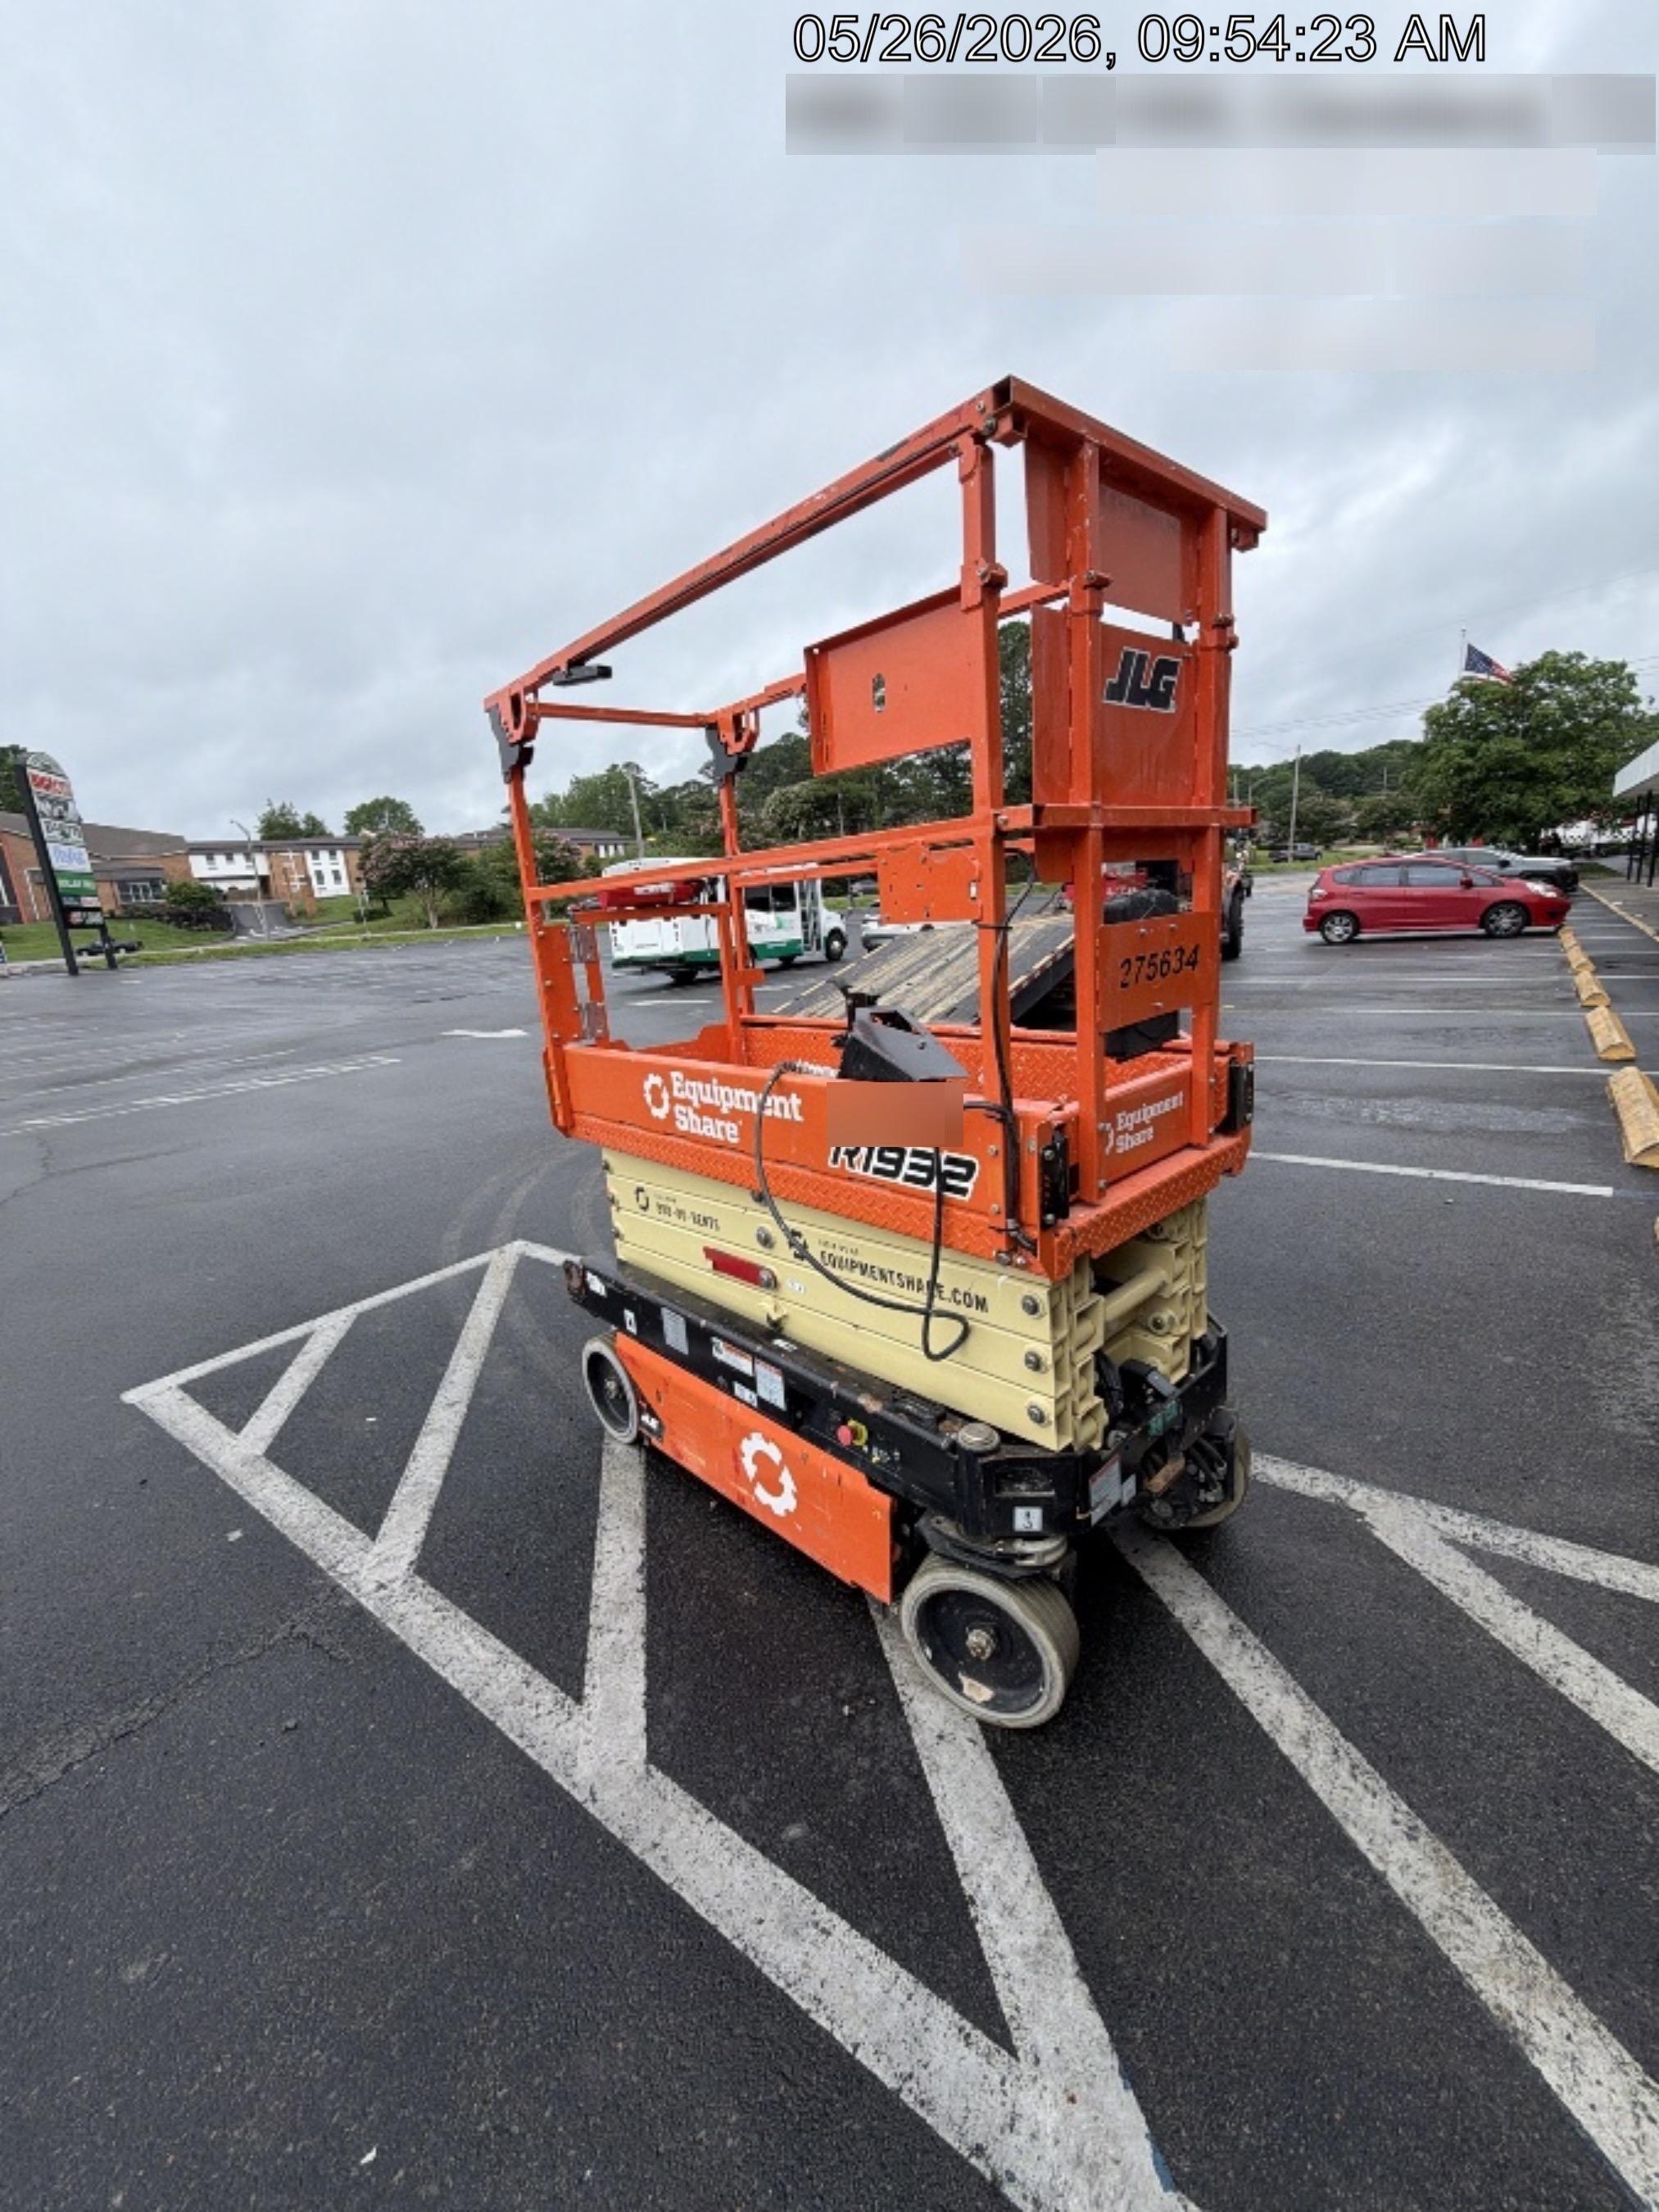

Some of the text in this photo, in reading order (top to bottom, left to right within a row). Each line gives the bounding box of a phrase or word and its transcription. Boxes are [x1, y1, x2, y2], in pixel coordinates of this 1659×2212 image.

[1103, 646, 1182, 713] JLG
[1119, 943, 1200, 990] 275634
[670, 1071, 805, 1122] Equipment
[673, 1104, 741, 1145] Share
